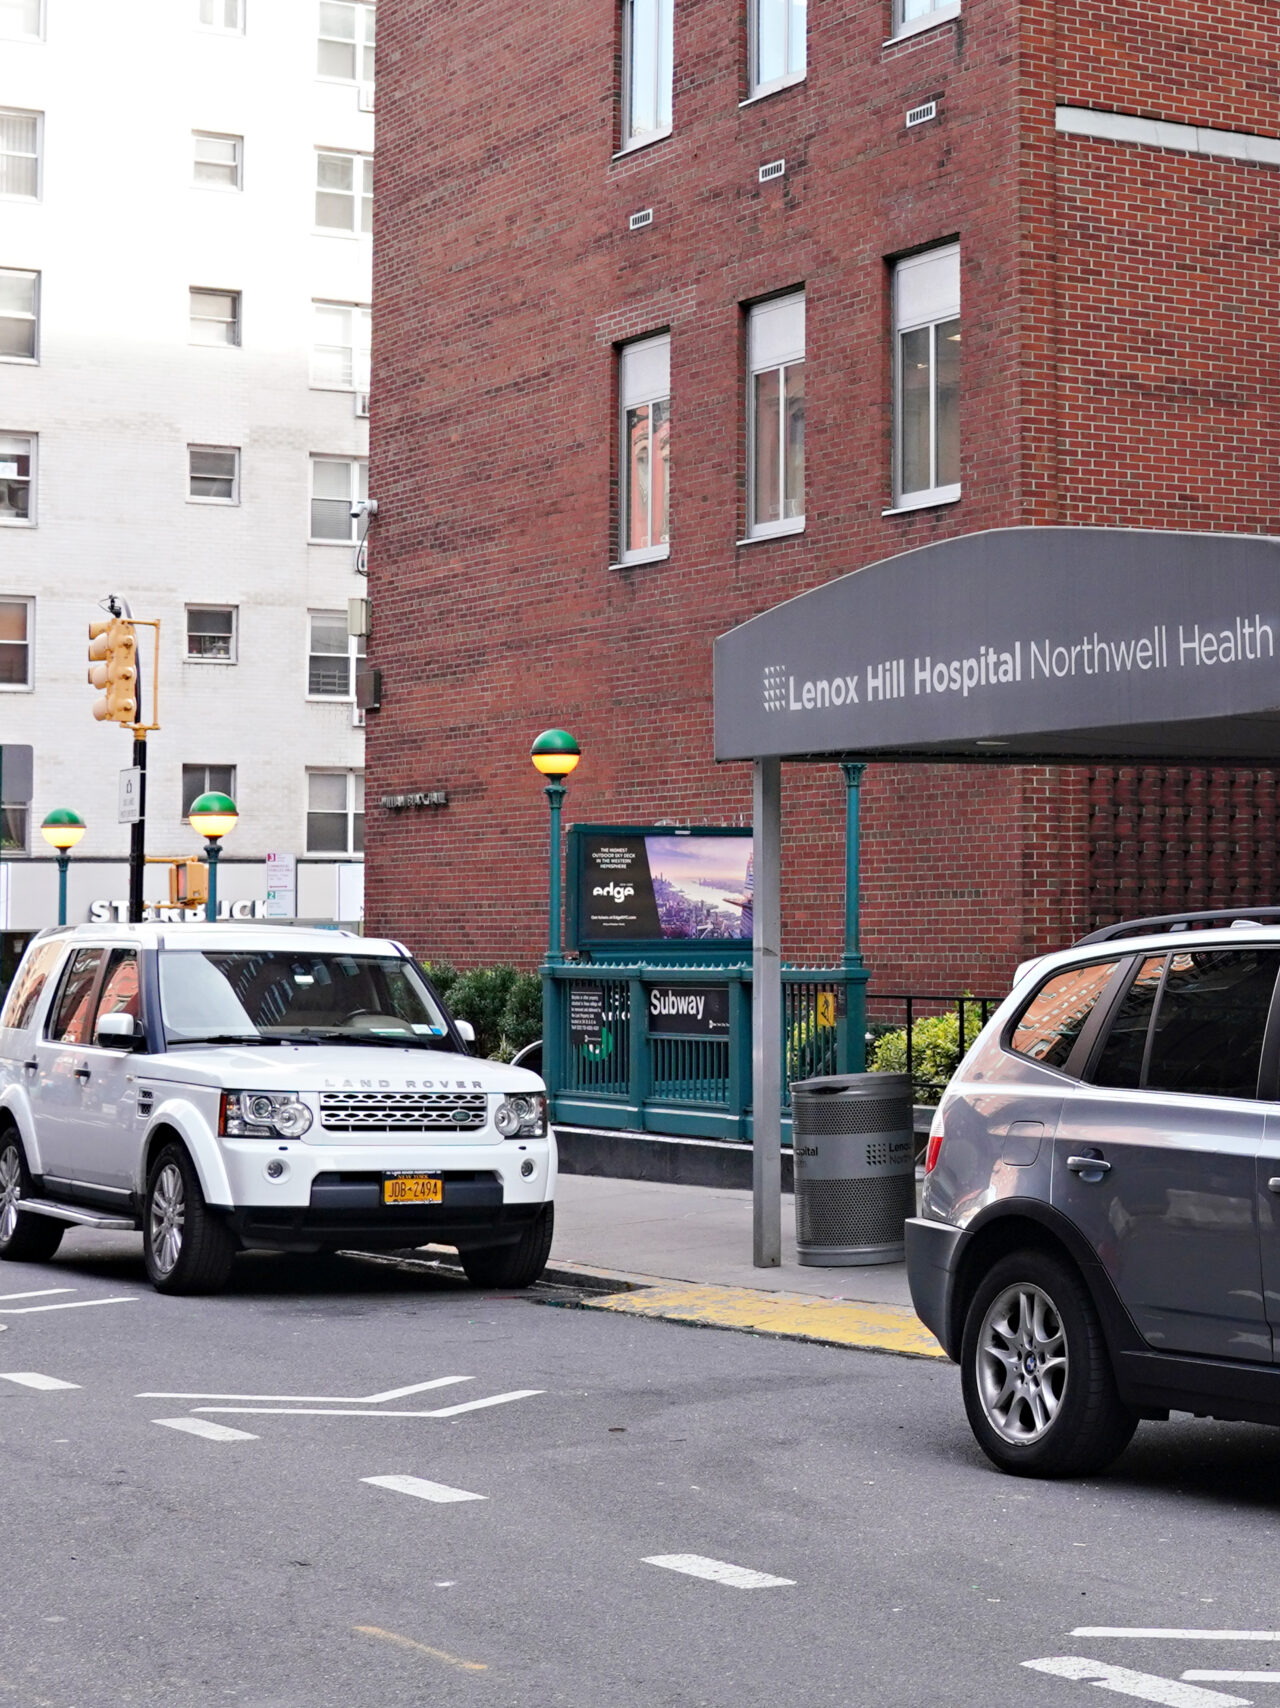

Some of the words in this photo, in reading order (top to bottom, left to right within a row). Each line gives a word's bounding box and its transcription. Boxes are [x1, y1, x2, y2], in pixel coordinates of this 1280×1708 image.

[788, 673, 860, 711] Lenox
[866, 658, 905, 702] Hill
[913, 641, 1021, 697] Hospital
[1030, 624, 1166, 680] Northwell
[1178, 614, 1275, 667] Health
[592, 881, 635, 903] edge
[650, 989, 705, 1020] Subway
[324, 1079, 391, 1088] LAND
[405, 1080, 483, 1089] ROVER
